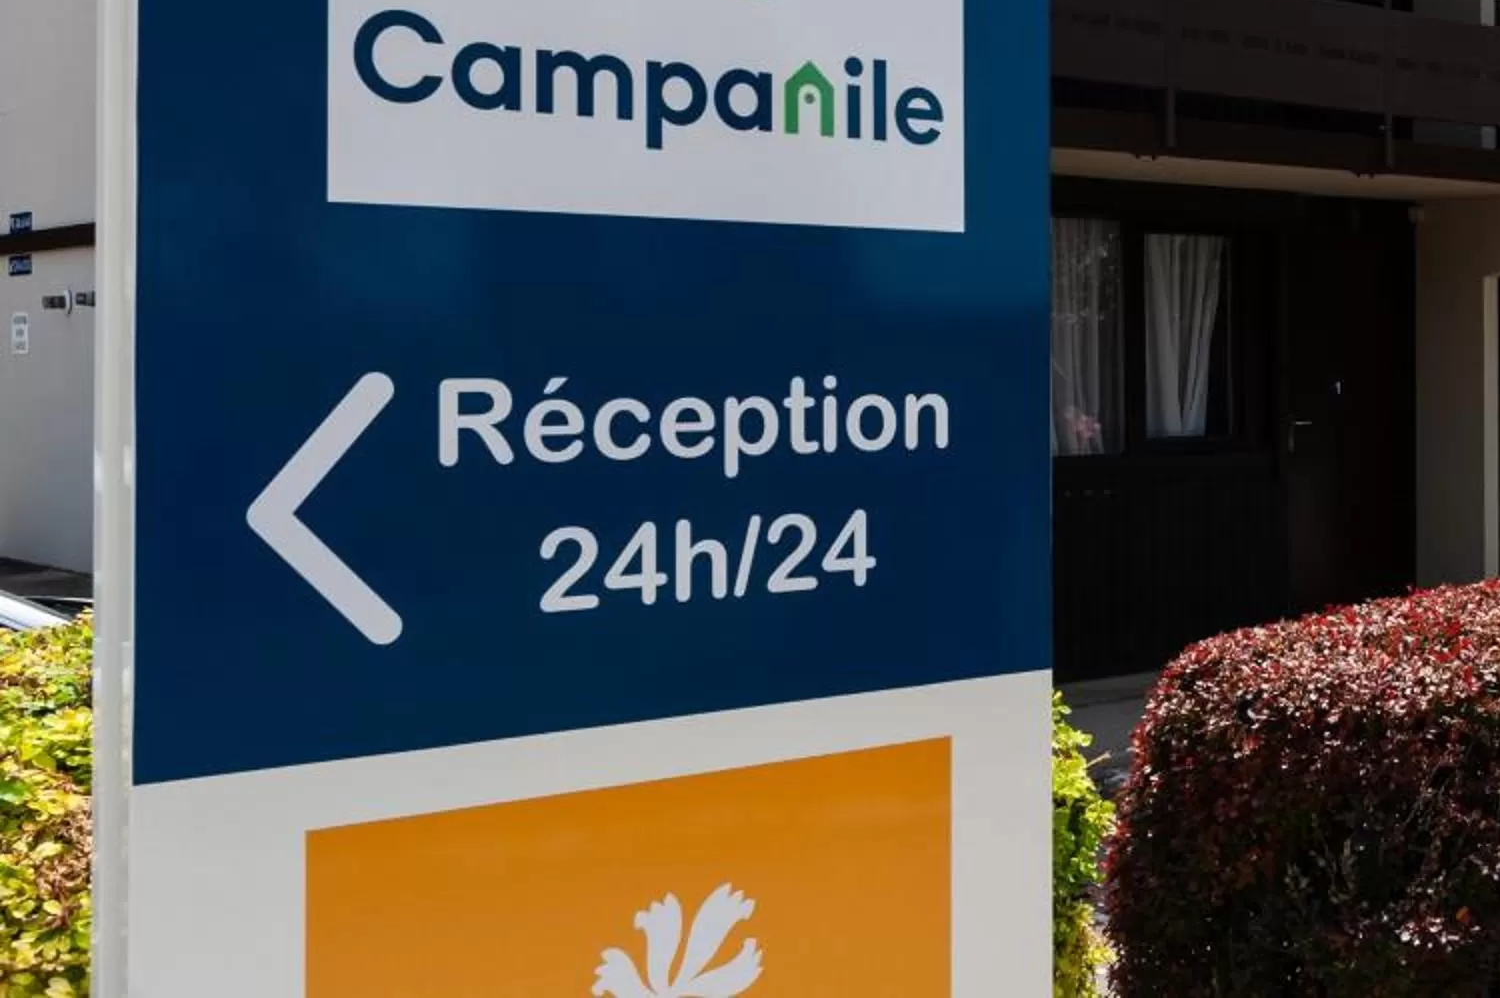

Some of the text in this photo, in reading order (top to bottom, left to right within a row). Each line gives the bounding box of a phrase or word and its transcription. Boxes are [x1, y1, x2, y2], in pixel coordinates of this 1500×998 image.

[353, 9, 945, 151] Campanile
[438, 375, 949, 478] Réception
[539, 509, 877, 613] 24h/24
